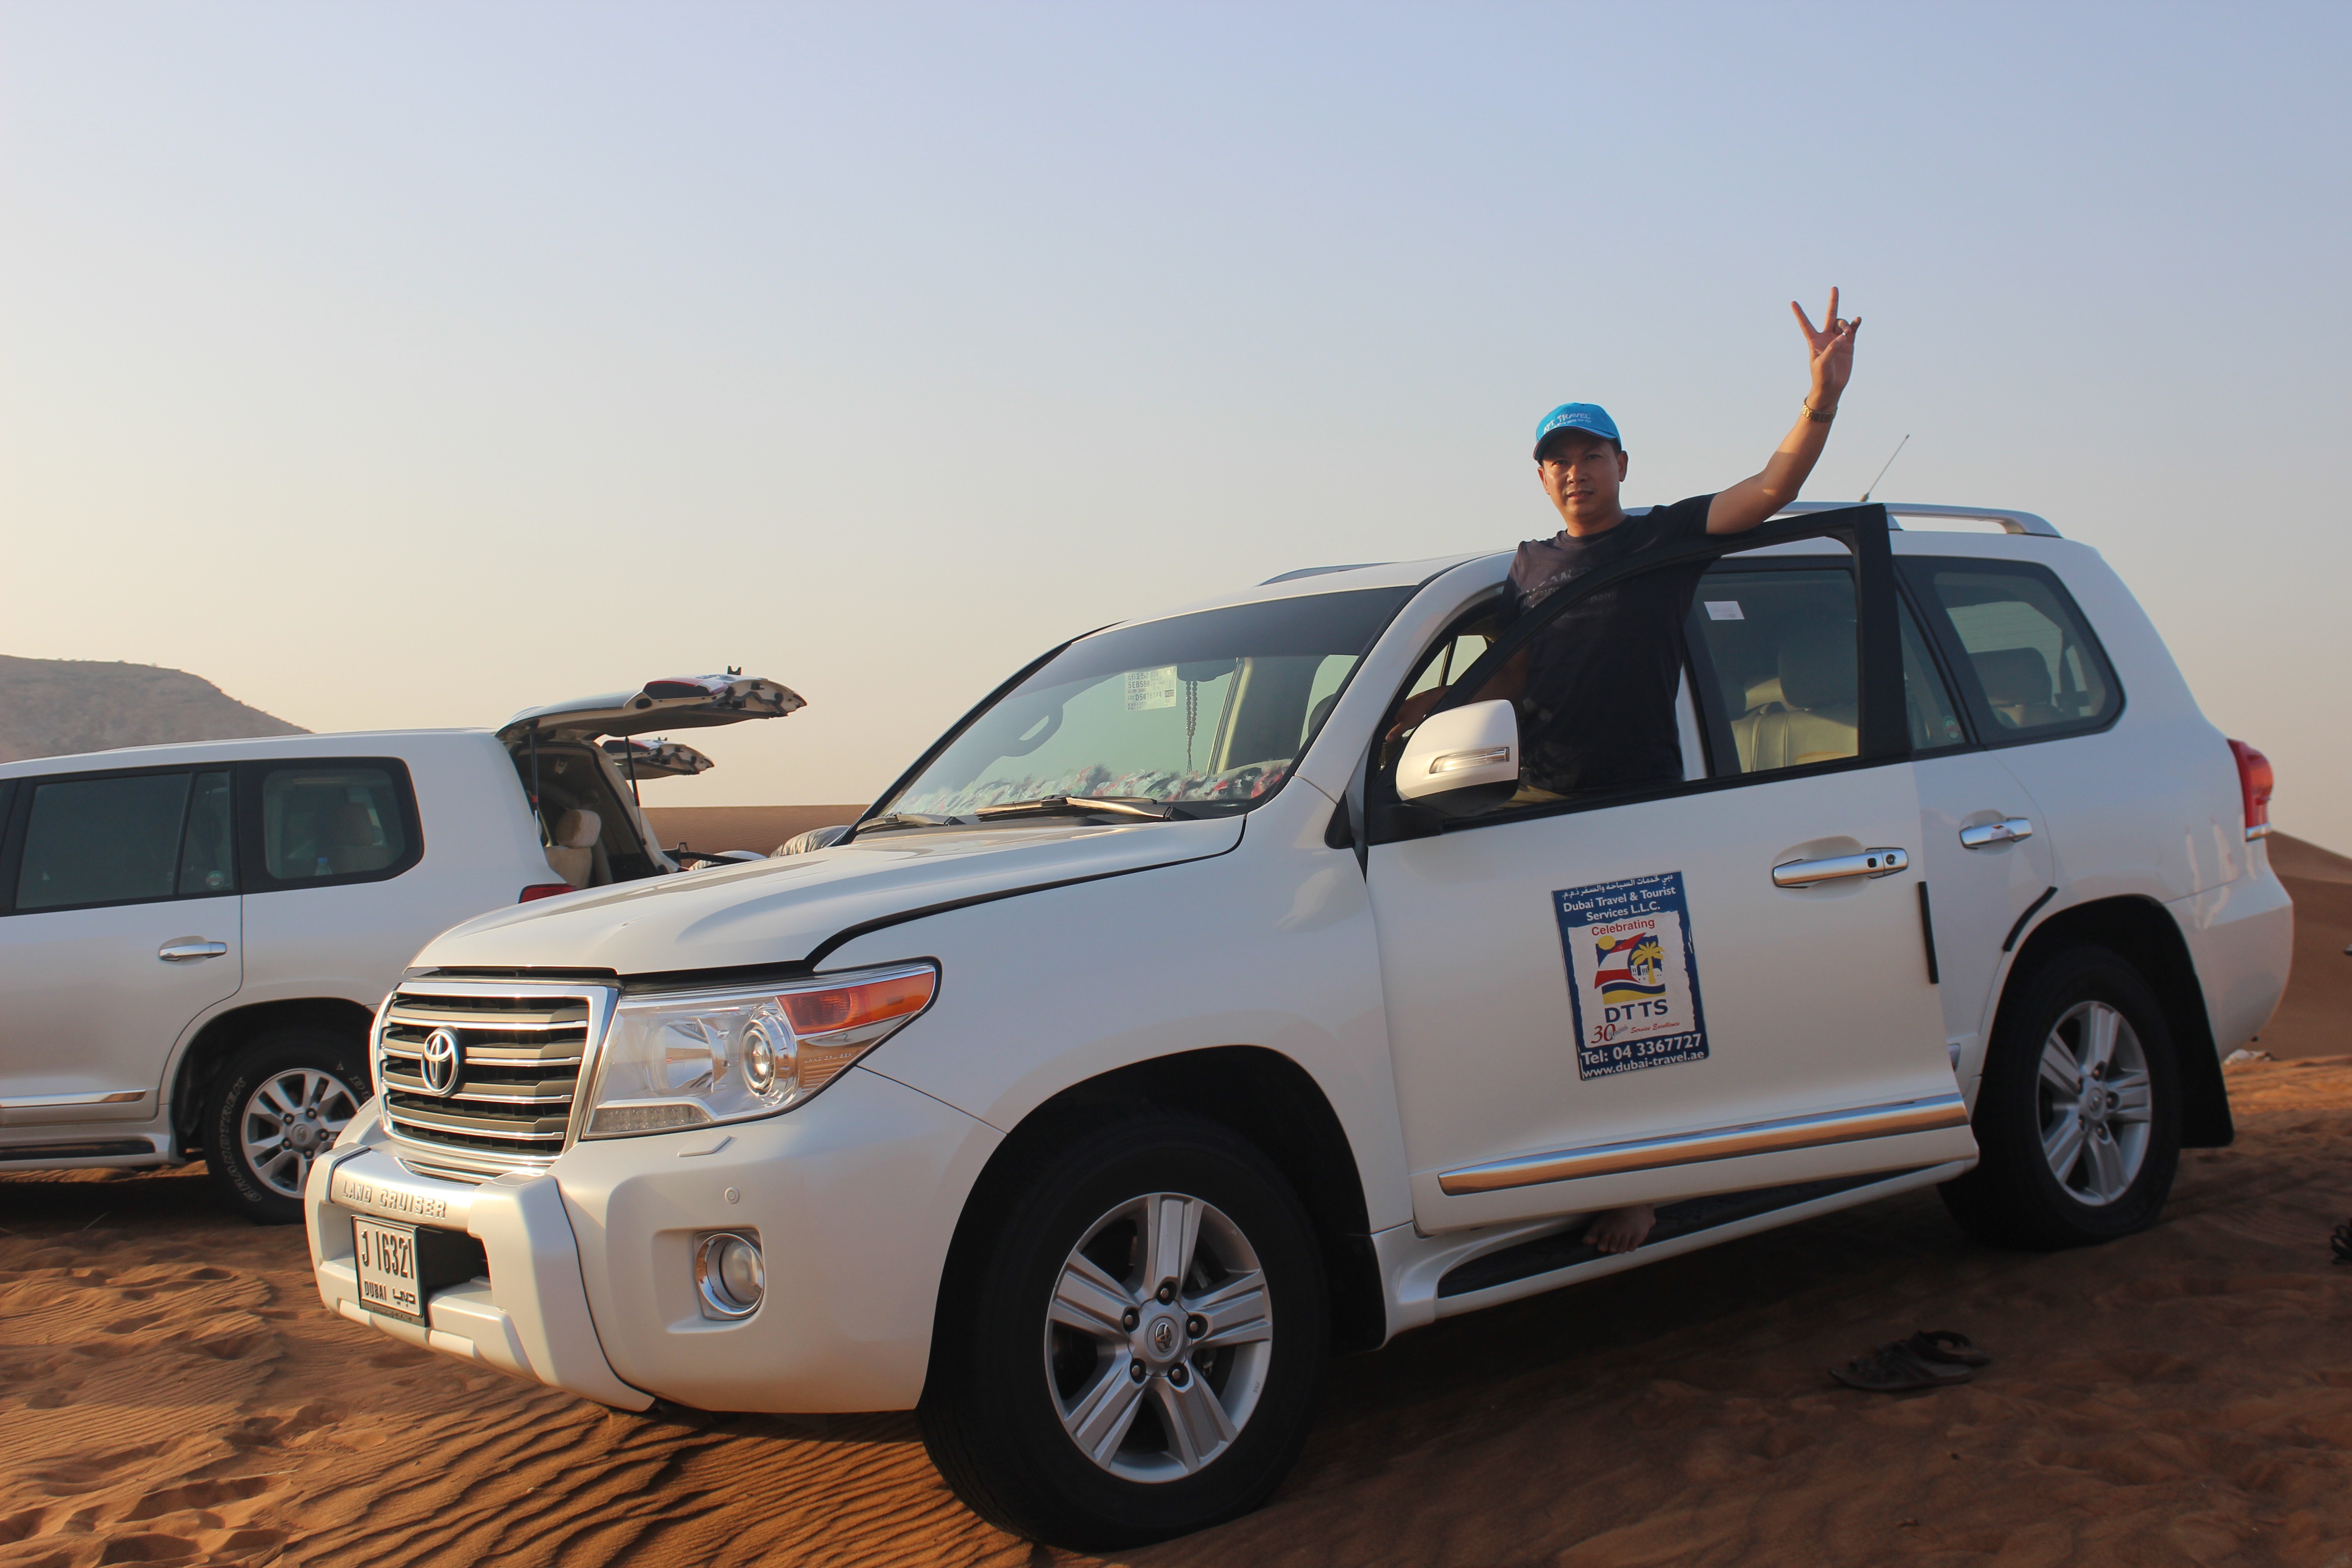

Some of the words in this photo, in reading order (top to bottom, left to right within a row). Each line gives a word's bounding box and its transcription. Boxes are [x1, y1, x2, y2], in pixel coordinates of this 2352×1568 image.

[1557, 413, 1591, 422] TRAVEL
[1128, 680, 1150, 688] 5EB580
[1563, 899, 1594, 912] Dubai
[1596, 893, 1627, 906] Travel
[1630, 892, 1638, 901] &
[1640, 886, 1676, 899] Tourist
[1586, 907, 1629, 921] Services
[1631, 901, 1661, 914] L.L.C.
[1592, 919, 1655, 936] Celebrating
[1604, 999, 1669, 1023] DTTS
[1591, 1024, 1616, 1044] 30
[1653, 1022, 1680, 1031] Excellence
[824, 1053, 852, 1061] CRUISER
[1581, 1050, 1608, 1065] Tel:
[1613, 1045, 1632, 1060] 04
[1637, 1034, 1701, 1056] 3367727
[1583, 1051, 1705, 1078] www.dubai-travel.ae
[219, 1076, 263, 1202] GRANDTREK
[343, 1180, 372, 1204] LAND
[378, 1188, 447, 1220] CRUISER
[361, 1229, 370, 1267] J
[375, 1229, 414, 1279] 16321
[363, 1279, 387, 1301] DUBAI
[392, 1286, 416, 1307] دبي
